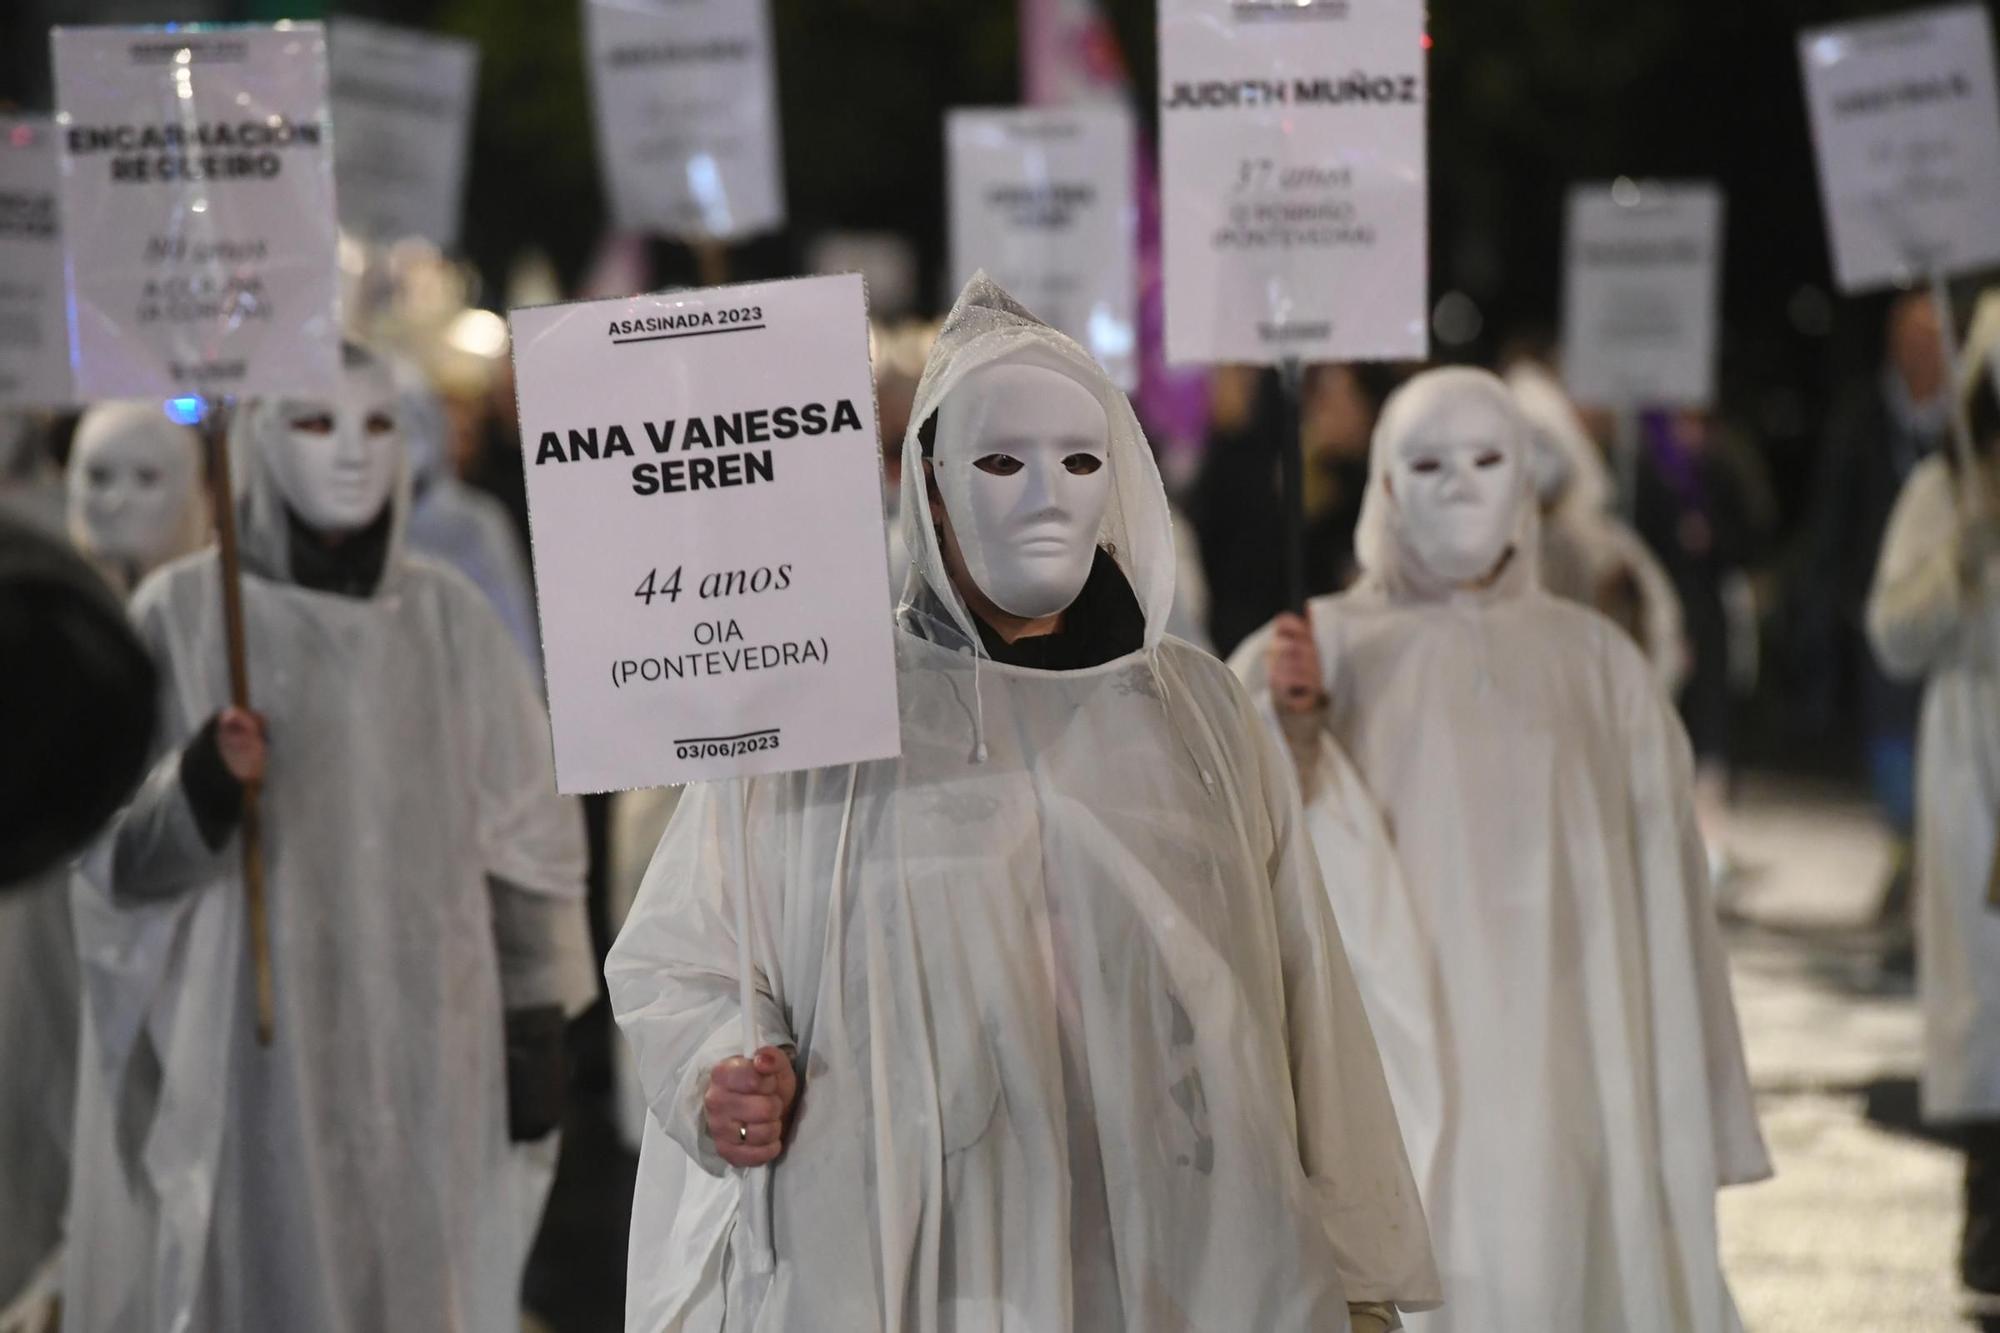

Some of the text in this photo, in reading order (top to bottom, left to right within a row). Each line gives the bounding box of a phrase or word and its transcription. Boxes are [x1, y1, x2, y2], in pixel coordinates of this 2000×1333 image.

[1165, 72, 1416, 109] JUDITH MUÑOZ
[608, 306, 764, 336] ASASINADA 2023
[535, 399, 863, 467] ANA VANESSA
[632, 450, 775, 497] SEREN
[633, 564, 793, 606] 44 anos
[693, 619, 745, 645] OIA
[611, 637, 829, 688] (PONTEVEDRA)
[676, 735, 780, 760] 03/06/2023
